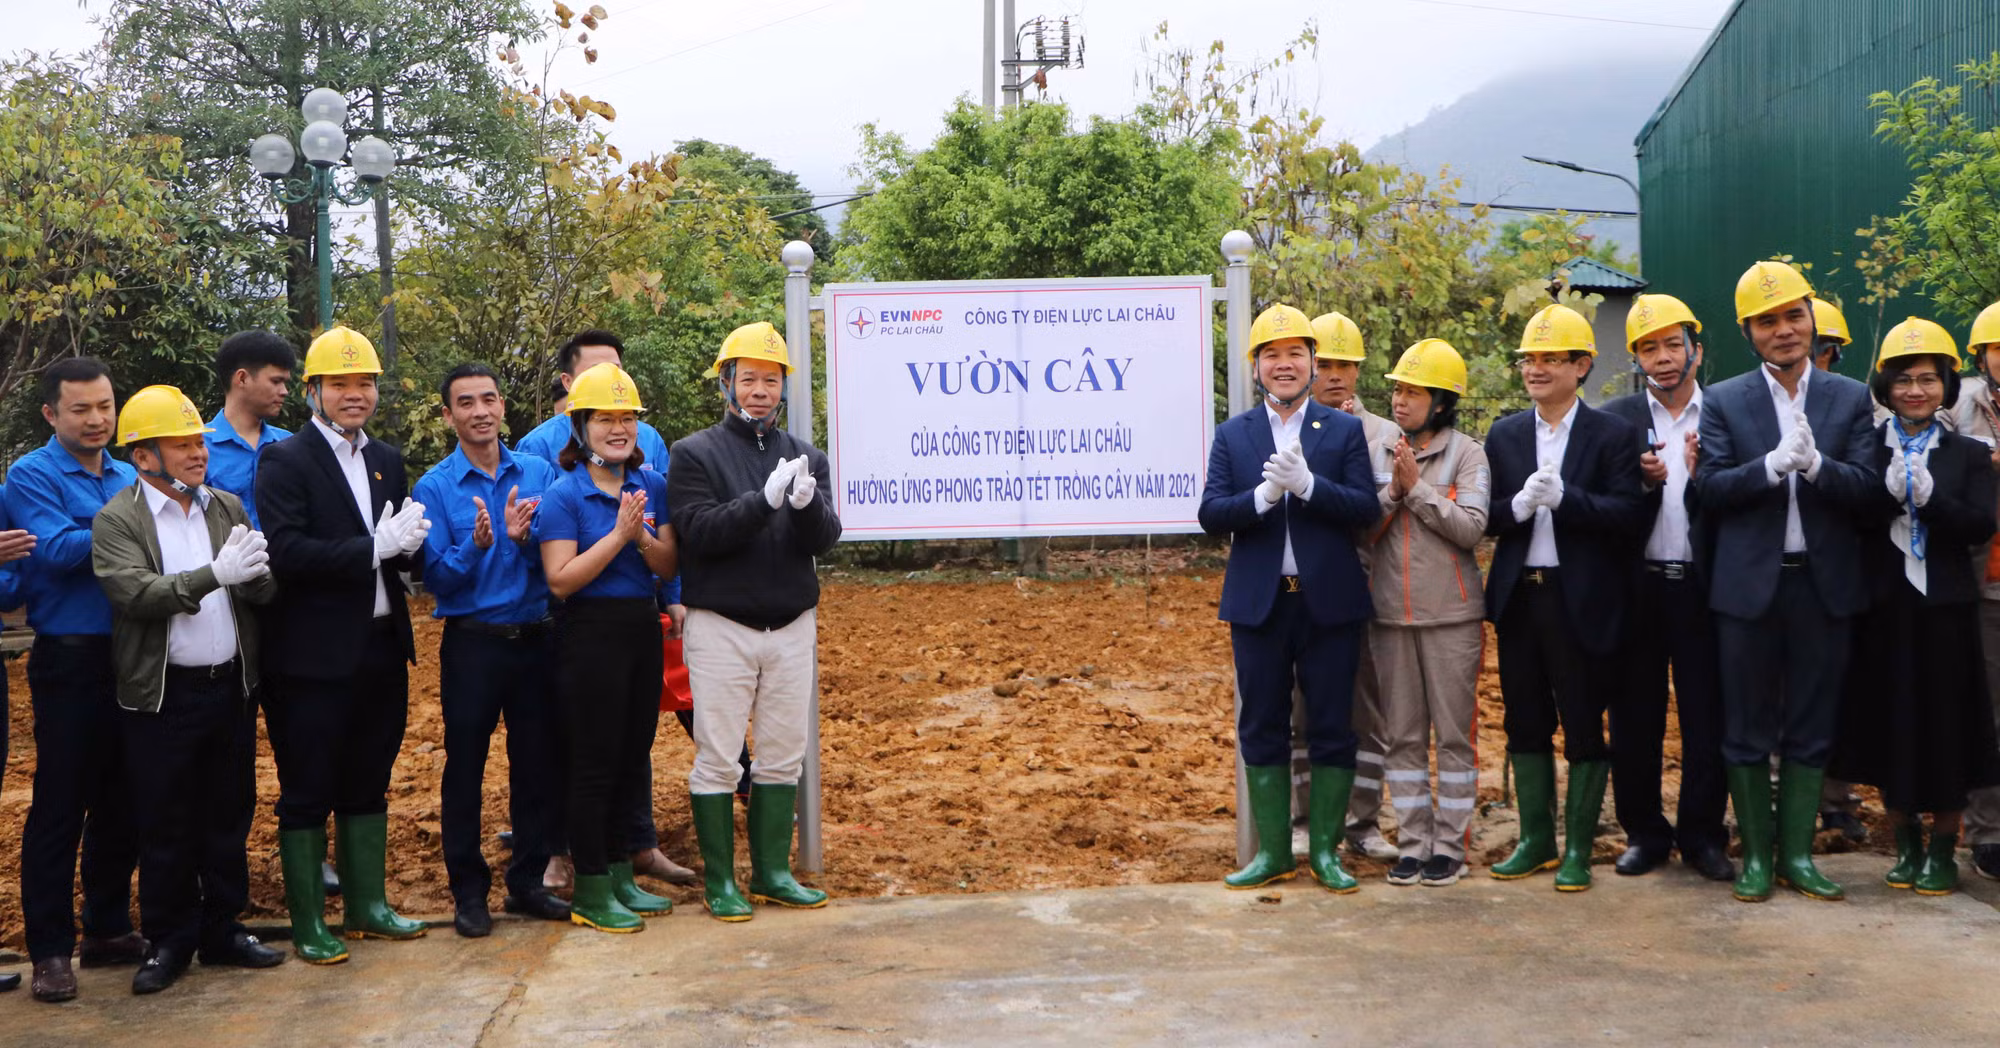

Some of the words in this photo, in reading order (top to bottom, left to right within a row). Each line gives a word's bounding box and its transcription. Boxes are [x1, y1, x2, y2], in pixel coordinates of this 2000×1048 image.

[880, 309, 943, 323] EVNNPC
[880, 326, 894, 335] PC
[896, 326, 913, 335] LAI
[964, 307, 1007, 325] CÔNG
[1011, 310, 1030, 324] TY
[1033, 307, 1068, 327] ĐIỆN
[1072, 308, 1103, 326] LỰC
[1107, 308, 1130, 322] LAI
[1134, 303, 1175, 322] CHÂU
[905, 350, 1029, 395] VƯỜN
[1043, 347, 1133, 393] CÂY
[911, 426, 939, 457] CỦA
[942, 424, 981, 456] CÔNG
[984, 430, 1001, 455] TY
[1004, 425, 1035, 461] ĐIỆN
[1039, 429, 1067, 460] LỰC
[1071, 428, 1091, 453] LAI
[1095, 421, 1132, 453] CHÂU
[848, 473, 898, 505] HƯỞNG
[902, 472, 932, 504] ỨNG
[936, 477, 983, 503] PHONG
[986, 470, 1023, 502] TRÀO
[1026, 470, 1051, 501] TẾT
[1055, 469, 1101, 500] TRỒNG
[1105, 467, 1132, 499] CÂY
[1136, 467, 1165, 498] NĂM
[1169, 473, 1196, 498] 2021
